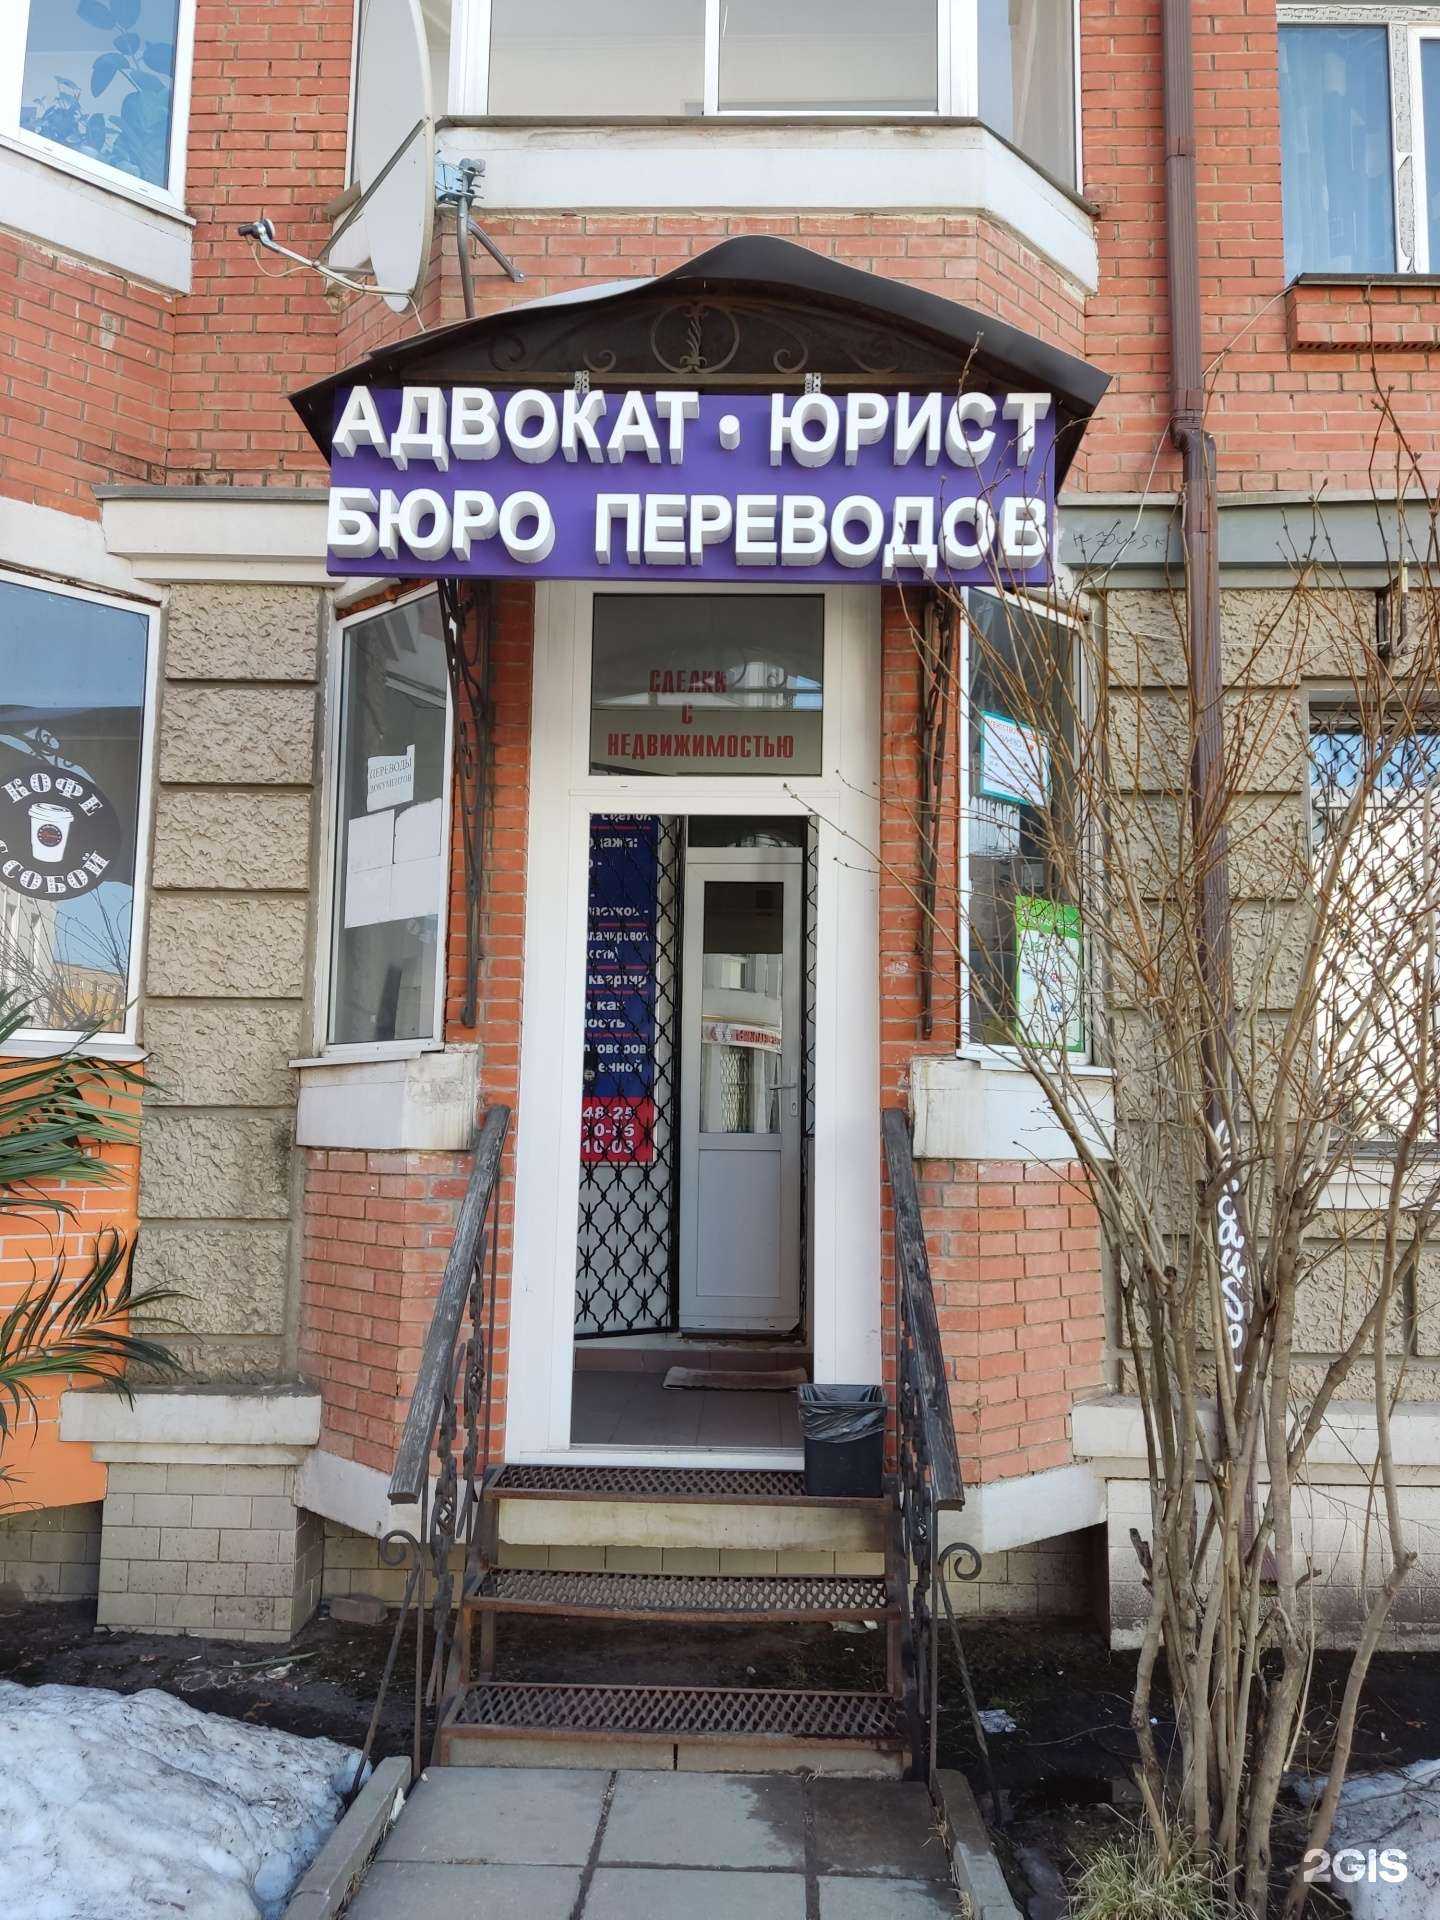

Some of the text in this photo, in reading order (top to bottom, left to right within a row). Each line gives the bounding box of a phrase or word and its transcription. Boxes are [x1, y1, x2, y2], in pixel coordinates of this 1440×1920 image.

[332, 385, 1051, 472] АДВОКАТ ЮРИСТ
[327, 487, 1048, 580] БЮРО ПЕРЕВОДОВ
[681, 703, 694, 725] С
[607, 732, 794, 760] НЕДВИЖИМОСТЬЮ
[1, 773, 103, 817] КОФЕ
[2, 850, 110, 894] СОБОЙ
